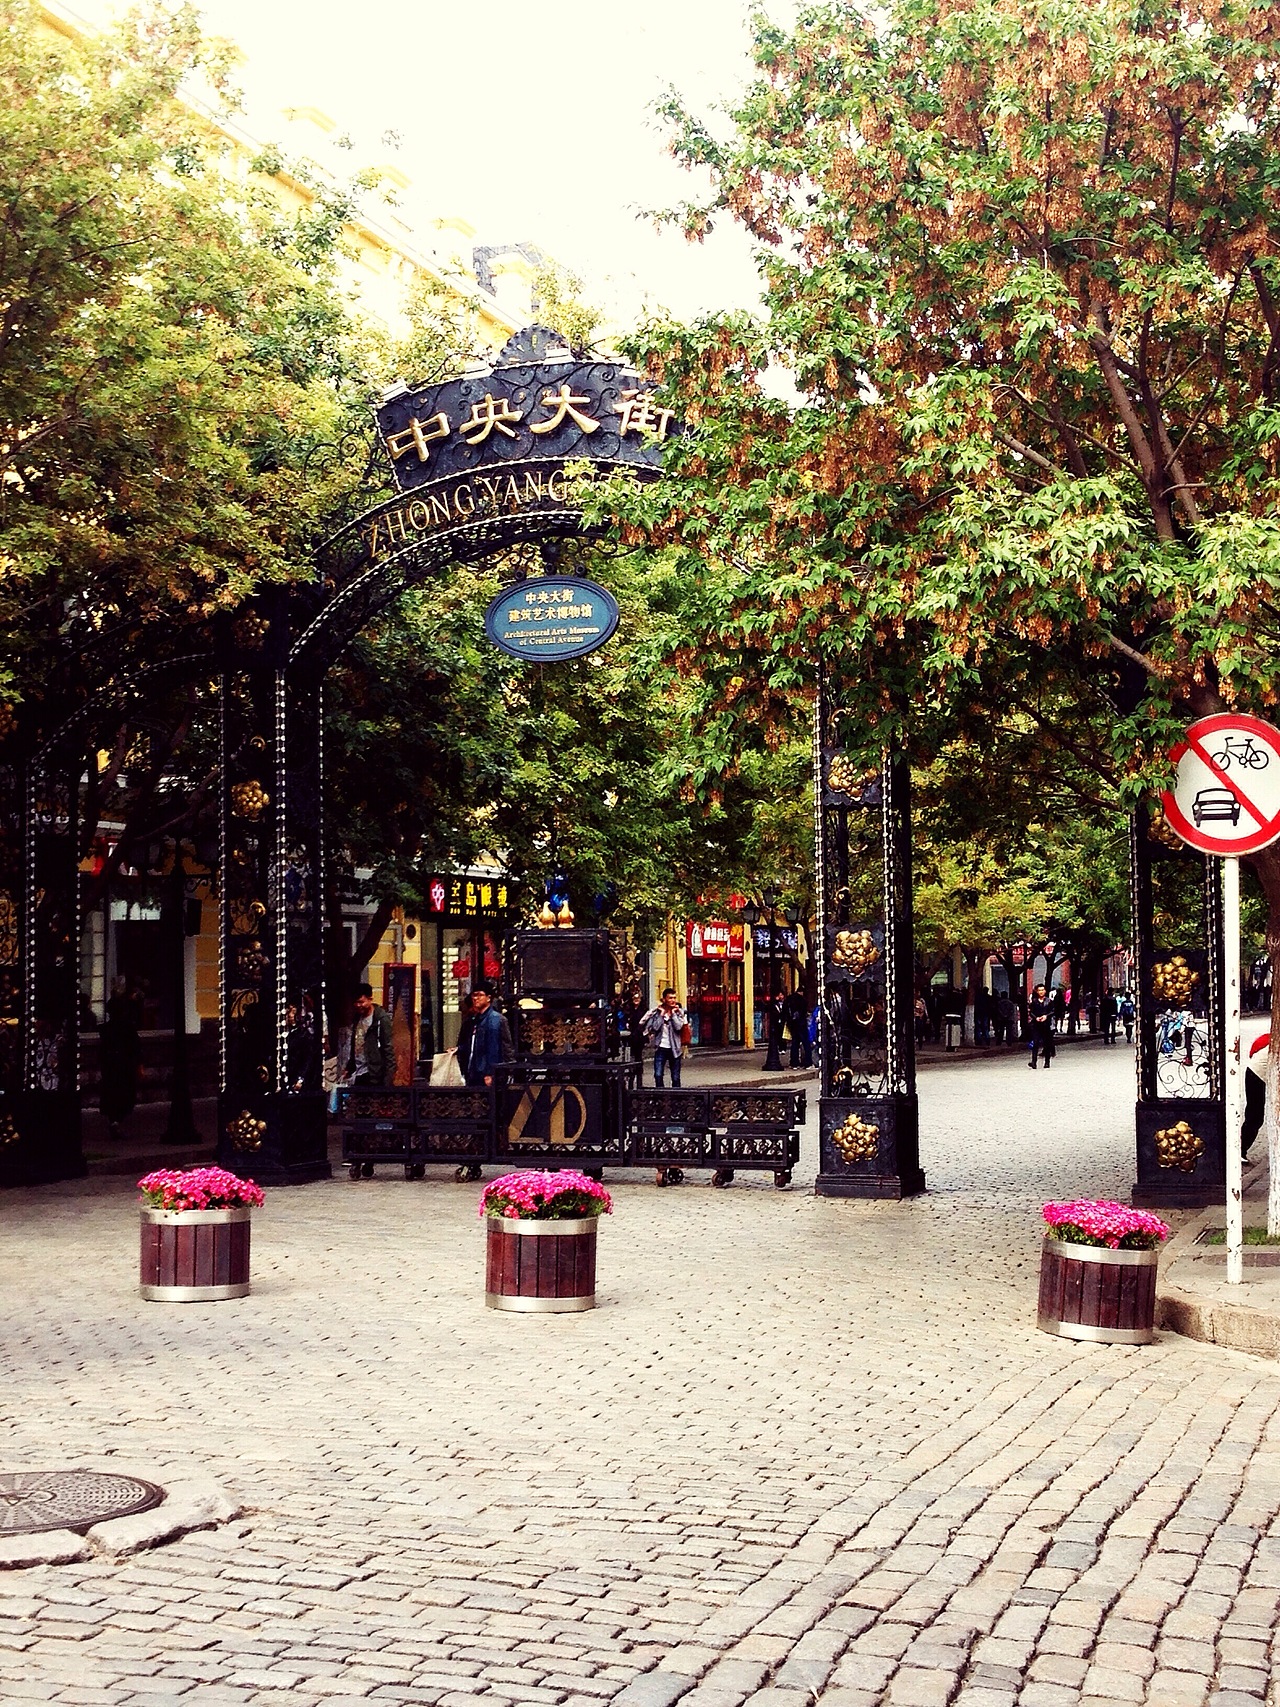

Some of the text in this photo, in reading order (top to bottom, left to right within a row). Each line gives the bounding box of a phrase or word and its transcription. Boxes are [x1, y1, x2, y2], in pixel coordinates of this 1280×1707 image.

[386, 383, 675, 462] 中央大街
[525, 589, 574, 604] 中央大街
[508, 603, 592, 622] 建筑艺术博物馆
[504, 627, 600, 639] Architectural Arts Museum
[529, 636, 556, 645] Central
[557, 635, 584, 643] Avenue
